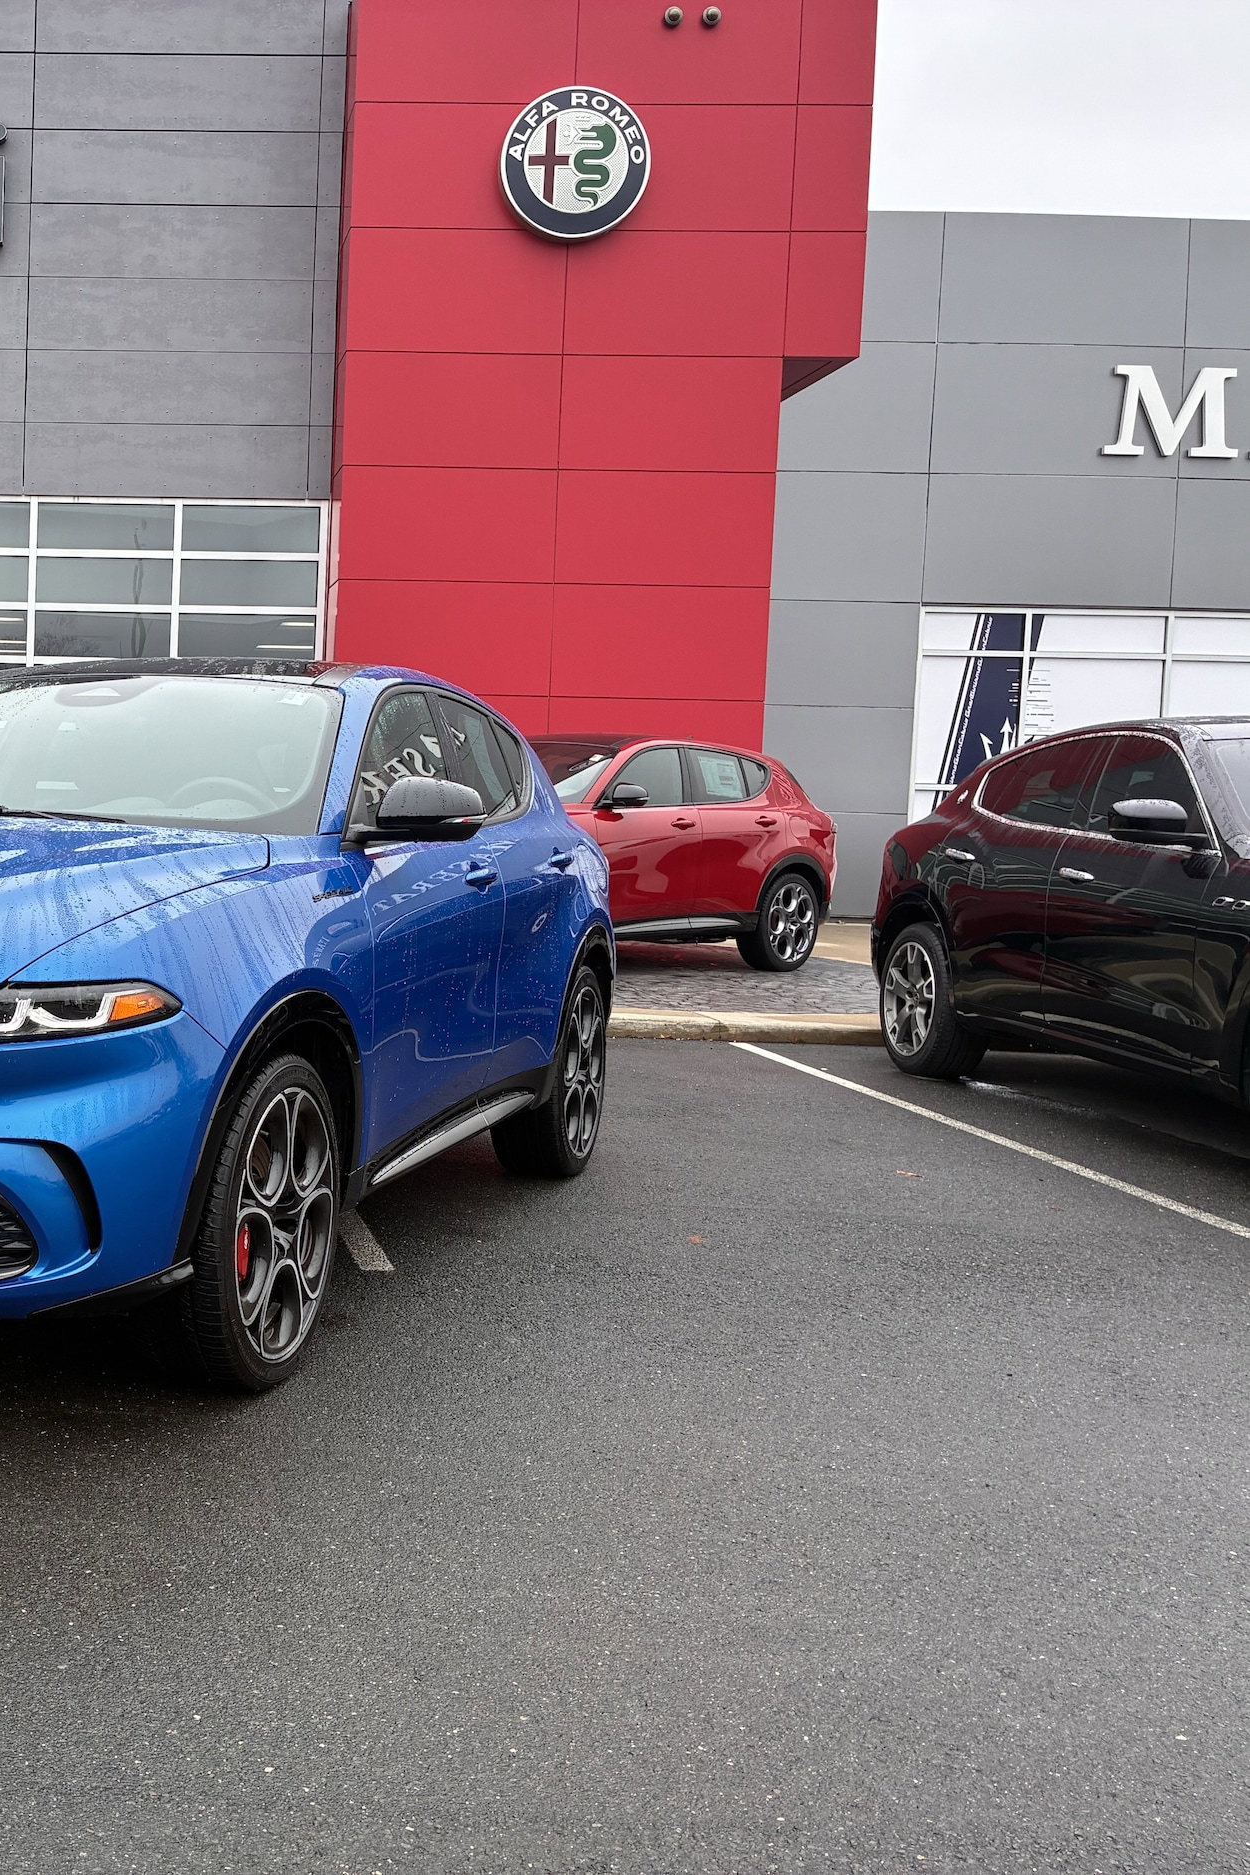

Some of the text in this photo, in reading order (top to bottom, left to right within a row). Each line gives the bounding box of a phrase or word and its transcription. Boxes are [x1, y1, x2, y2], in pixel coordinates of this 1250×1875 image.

[508, 92, 645, 164] ALFA ROMEO
[1100, 364, 1250, 459] M
